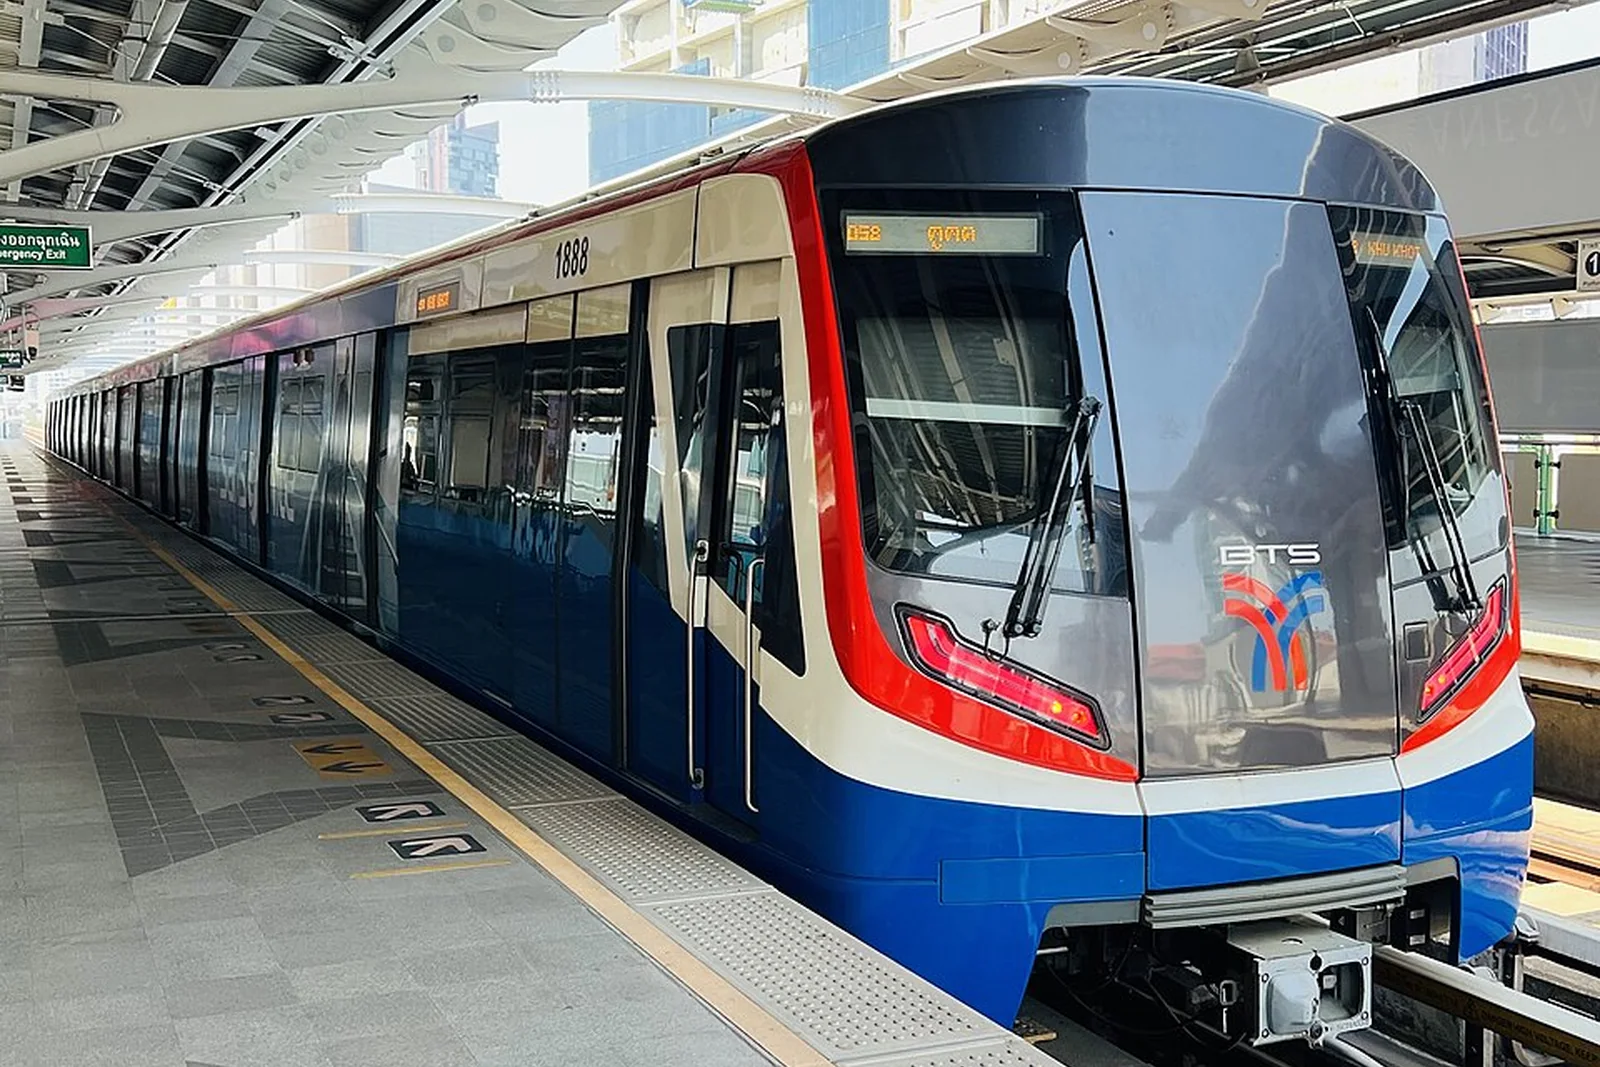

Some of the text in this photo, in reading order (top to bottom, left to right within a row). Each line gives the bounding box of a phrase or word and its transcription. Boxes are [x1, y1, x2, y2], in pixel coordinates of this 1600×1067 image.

[46, 249, 66, 259] Exit
[555, 236, 589, 279] 1888
[1589, 253, 1598, 273] 1
[1220, 543, 1321, 565] BTS
